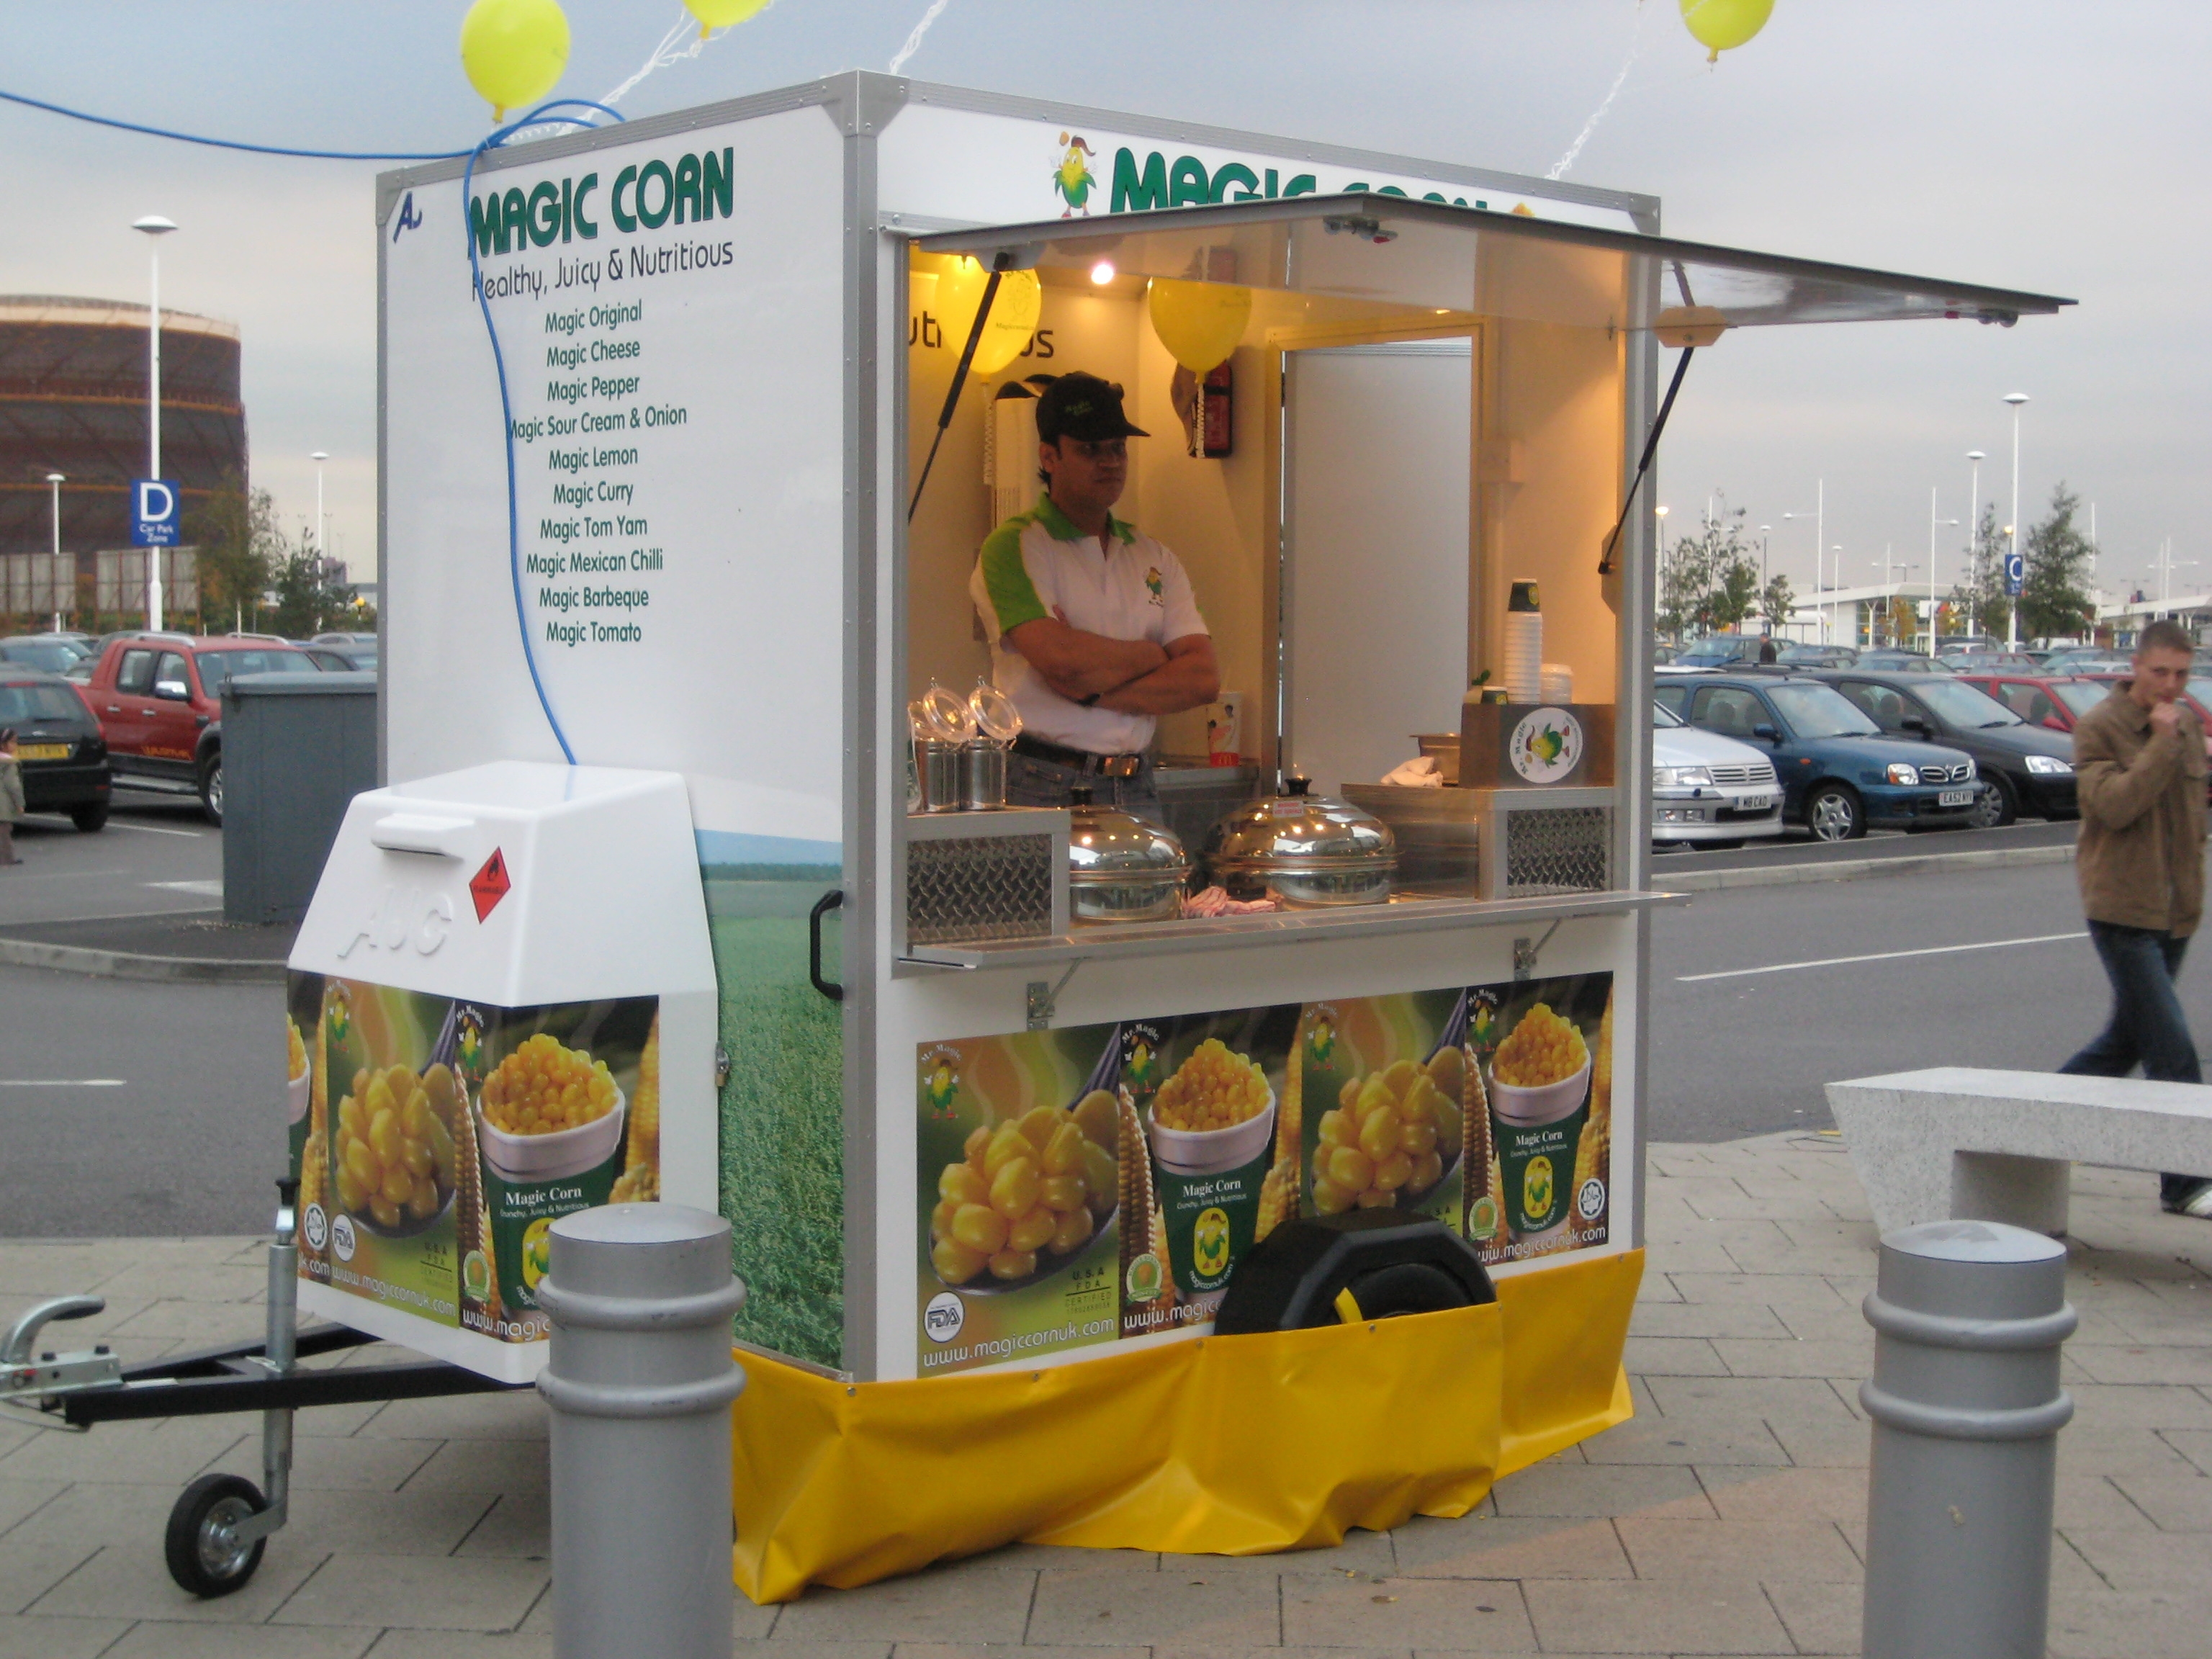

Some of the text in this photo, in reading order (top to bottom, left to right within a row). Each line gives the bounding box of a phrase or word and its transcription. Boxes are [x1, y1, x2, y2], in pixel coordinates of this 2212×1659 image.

[467, 146, 734, 261] MAGIC CORN
[554, 257, 601, 293] Juicy
[608, 248, 624, 281] &
[630, 240, 734, 278] Nutritious
[544, 298, 643, 336] Magic Original
[547, 338, 641, 370] Magic Cheese
[547, 375, 642, 405] Magic Pepper
[547, 415, 577, 436] Sour
[580, 411, 626, 433] Cream
[629, 407, 641, 428] &
[644, 403, 688, 427] Onion
[549, 446, 639, 475] Magic Lemon
[140, 482, 174, 522] D
[553, 480, 634, 508] Magic Curry
[139, 523, 174, 534] Car Park
[146, 533, 168, 543] Zone
[540, 516, 648, 544] Magic Tom Yam
[526, 548, 664, 579] Magic Mexican Chilli
[2010, 556, 2023, 581] C
[539, 585, 649, 613] Magic Barbeque
[546, 621, 642, 647] Magic Tomato
[1515, 1130, 1563, 1147] Magic Corn
[505, 1187, 583, 1207] Magic Corn
[1183, 1179, 1241, 1198] Magic Corn
[1478, 1226, 1606, 1262] ww.magiccornuk.com
[332, 1265, 457, 1317] www.magiccornuk.com
[927, 1307, 961, 1329] FDA
[924, 1318, 1114, 1367] www.magiccornuk.com
